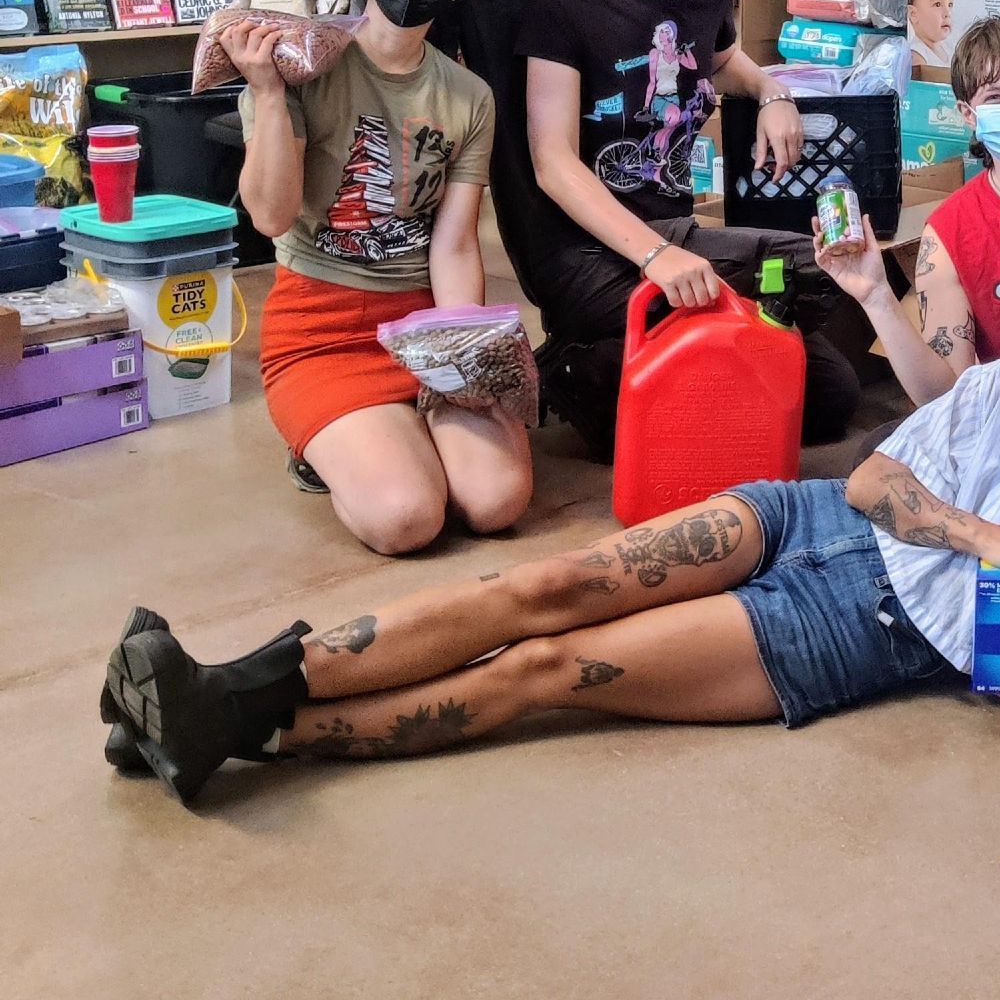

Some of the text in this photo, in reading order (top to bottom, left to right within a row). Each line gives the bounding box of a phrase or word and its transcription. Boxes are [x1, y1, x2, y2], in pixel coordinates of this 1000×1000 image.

[133, 5, 160, 14] SCHOOL
[33, 74, 51, 93] of
[179, 281, 205, 290] PURINA
[173, 289, 205, 303] TIDY
[171, 300, 206, 314] CATS
[176, 328, 197, 338] FREE
[175, 335, 203, 345] CLEAN
